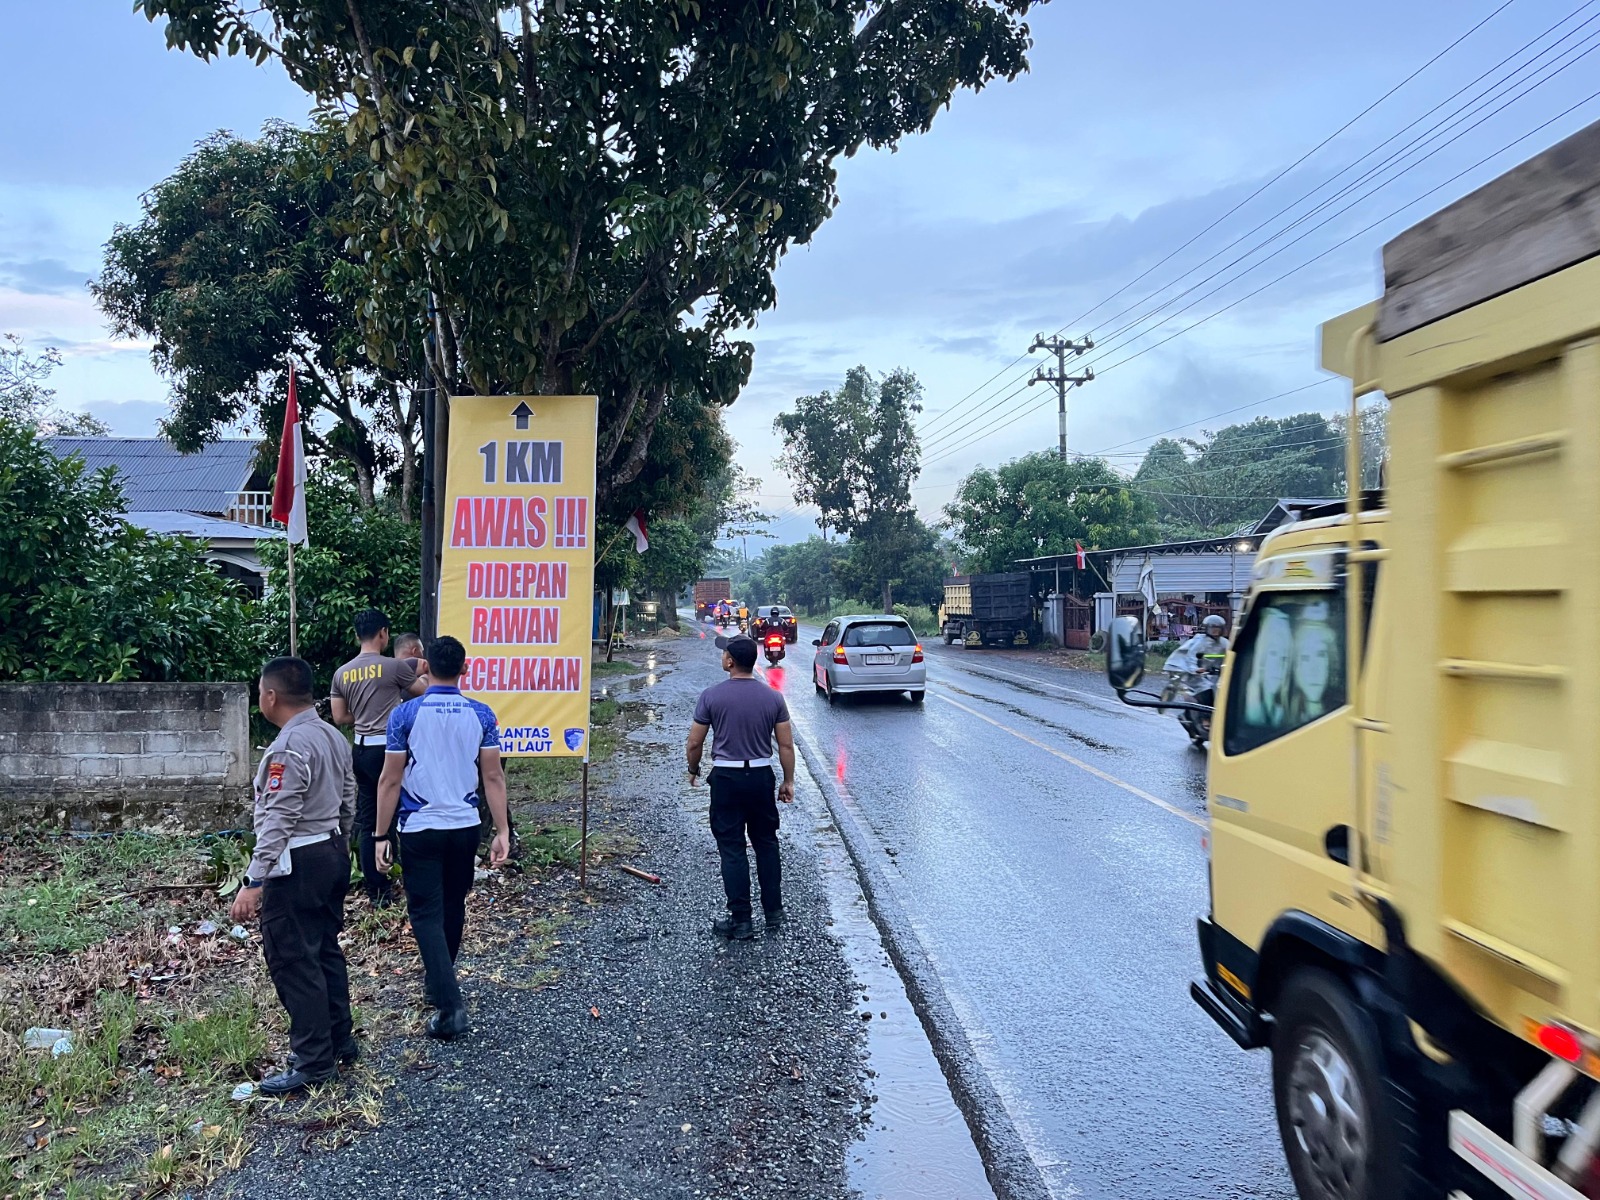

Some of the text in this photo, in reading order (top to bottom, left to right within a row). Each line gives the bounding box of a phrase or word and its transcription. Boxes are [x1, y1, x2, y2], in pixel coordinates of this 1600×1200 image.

[479, 441, 562, 483] 1 KM
[451, 496, 587, 548] AWAS !!!
[467, 562, 567, 599] DIDEPAN
[471, 606, 559, 644] RAWAN
[343, 664, 382, 685] POLISI
[460, 657, 581, 691] ECELAKAAN
[518, 741, 552, 752] LAUT
